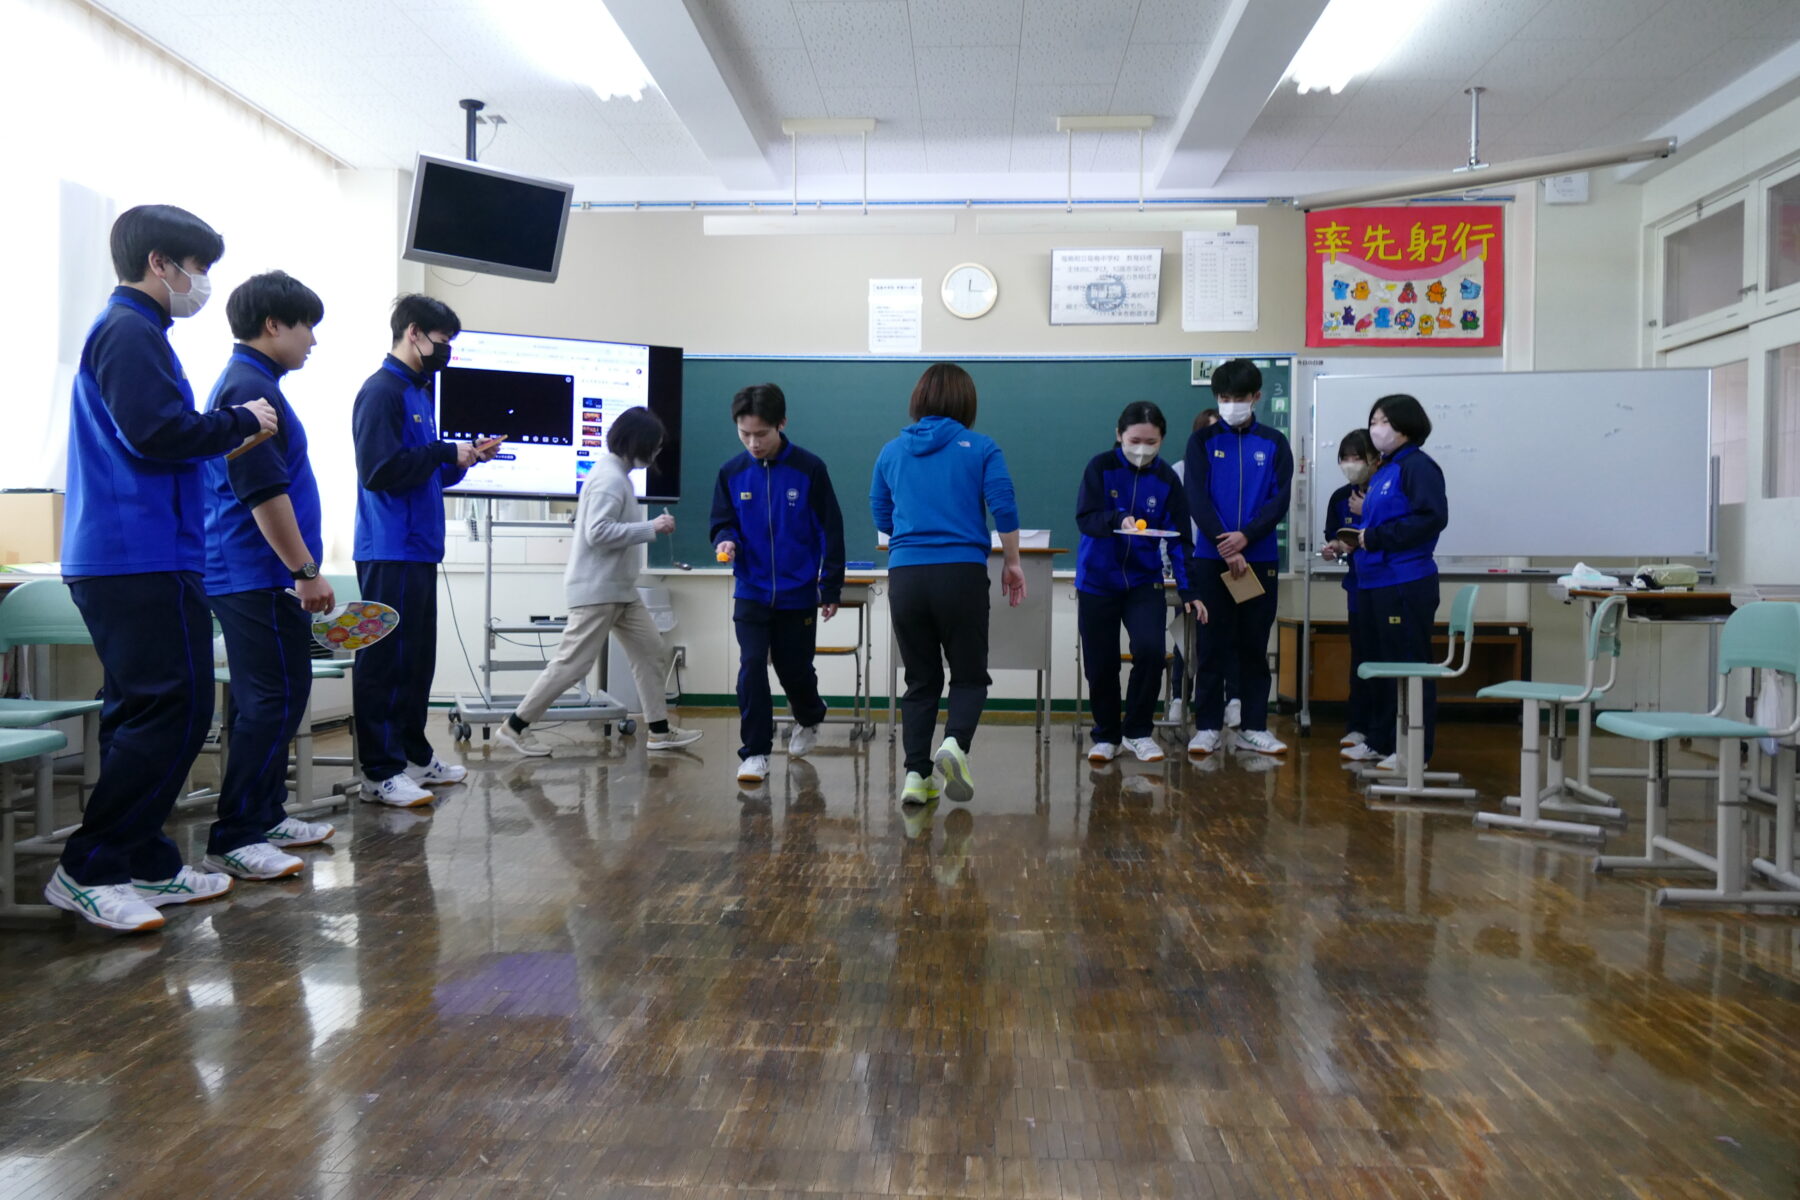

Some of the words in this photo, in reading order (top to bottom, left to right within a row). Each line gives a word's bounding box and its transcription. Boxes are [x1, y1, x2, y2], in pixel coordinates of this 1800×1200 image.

[1313, 221, 1495, 264] 率先躬行
[1273, 382, 1284, 396] 3
[1275, 399, 1286, 411] 月
